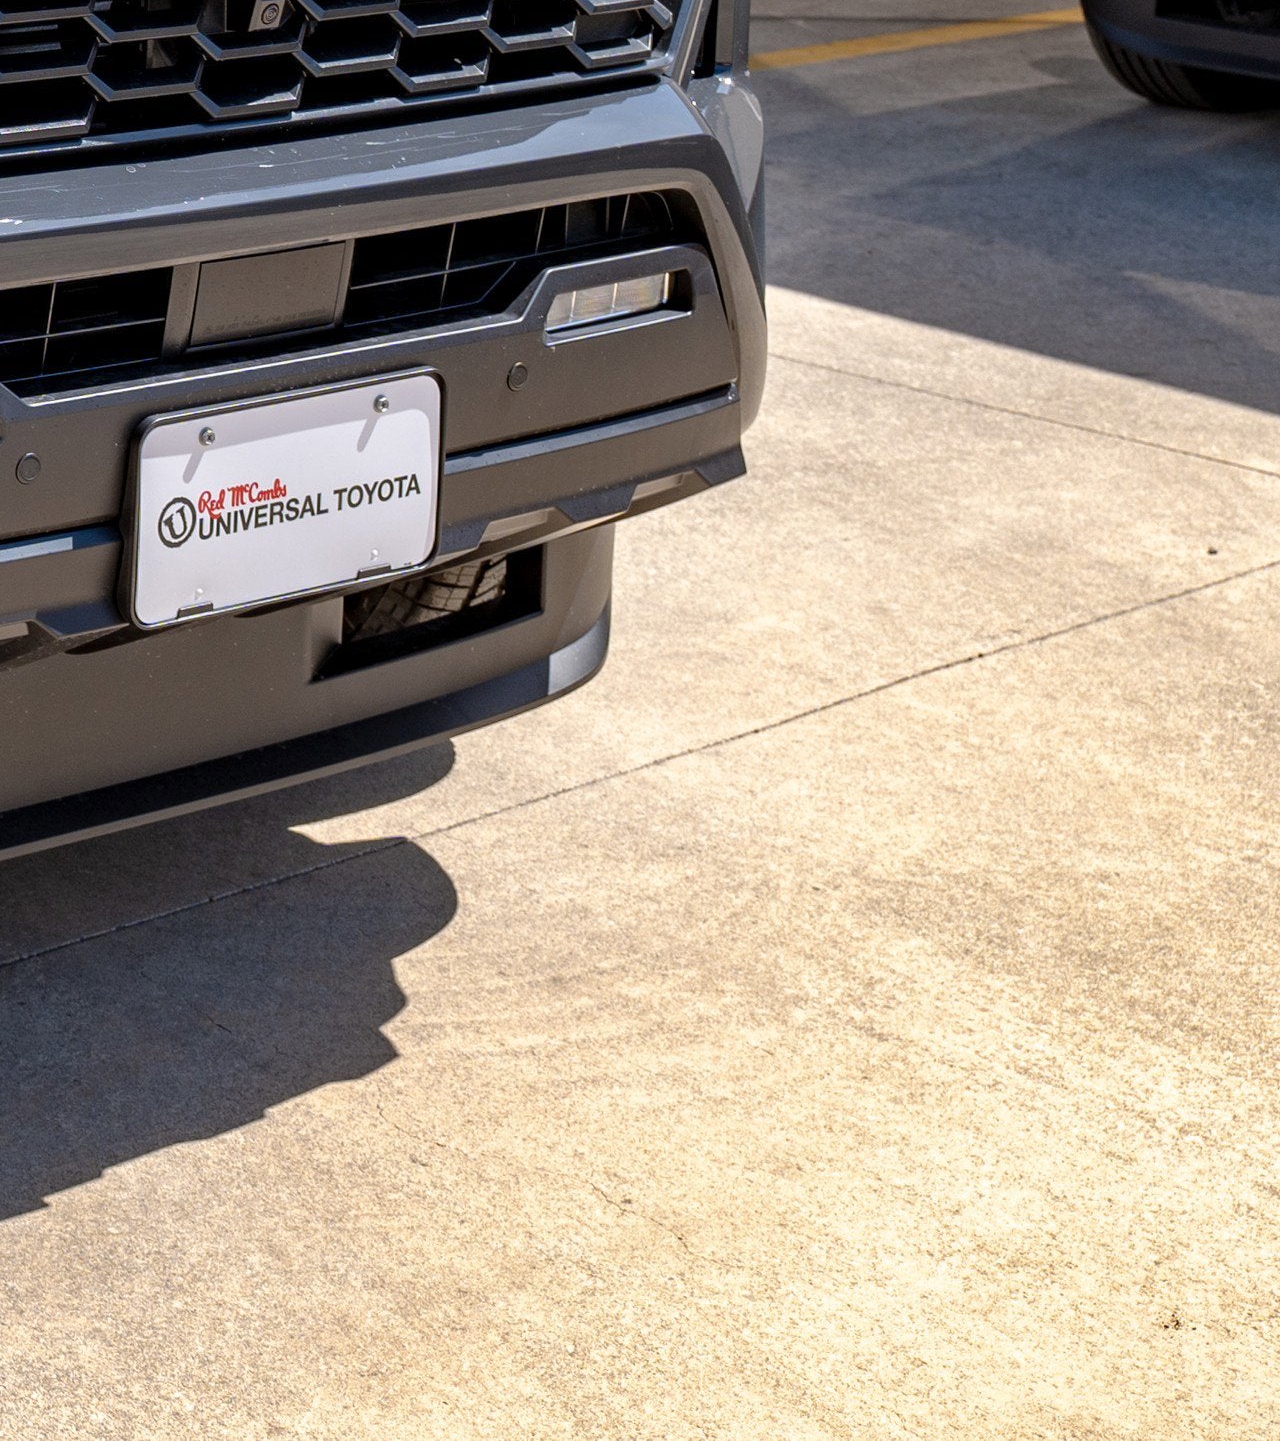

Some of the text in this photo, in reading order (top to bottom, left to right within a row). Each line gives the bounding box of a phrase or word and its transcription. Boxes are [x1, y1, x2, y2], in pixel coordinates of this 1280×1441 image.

[198, 478, 287, 519] Red McCombs
[198, 473, 421, 540] UNIVERSAL TOYOTA
